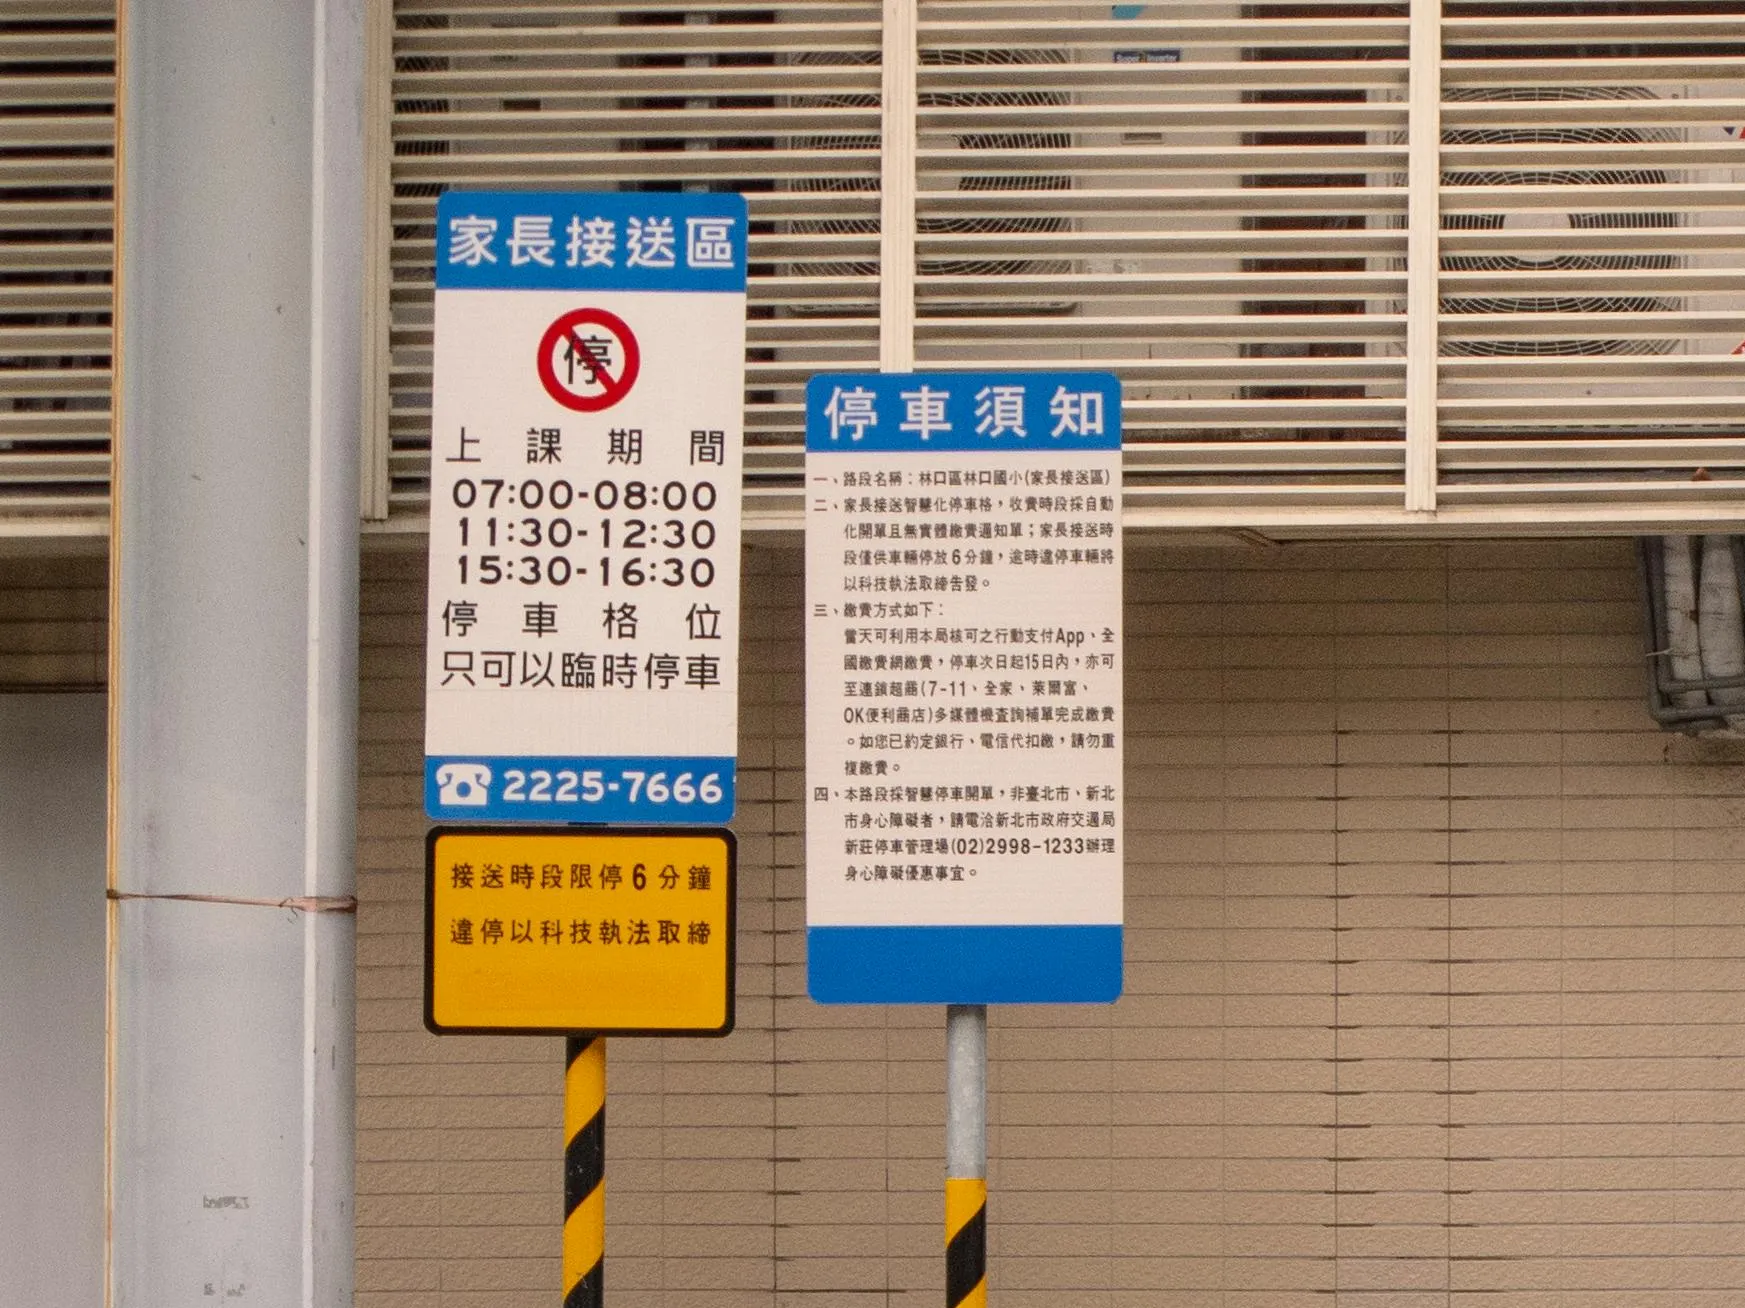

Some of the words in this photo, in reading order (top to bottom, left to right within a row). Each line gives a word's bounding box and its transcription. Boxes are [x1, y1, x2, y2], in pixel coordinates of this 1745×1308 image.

[449, 214, 735, 268] 家長接送區
[824, 385, 1104, 441] 停車須知
[446, 427, 724, 466] 上課期間
[453, 478, 716, 511] 07:00-08:00
[460, 517, 715, 549] 11:30-12:30
[459, 555, 714, 588] 15:30-16:30
[442, 600, 721, 640] 停車格位
[441, 651, 720, 690] 只可以臨時停車
[503, 769, 722, 804] 2225-7666
[451, 918, 711, 945] 違停以科技執法取締
